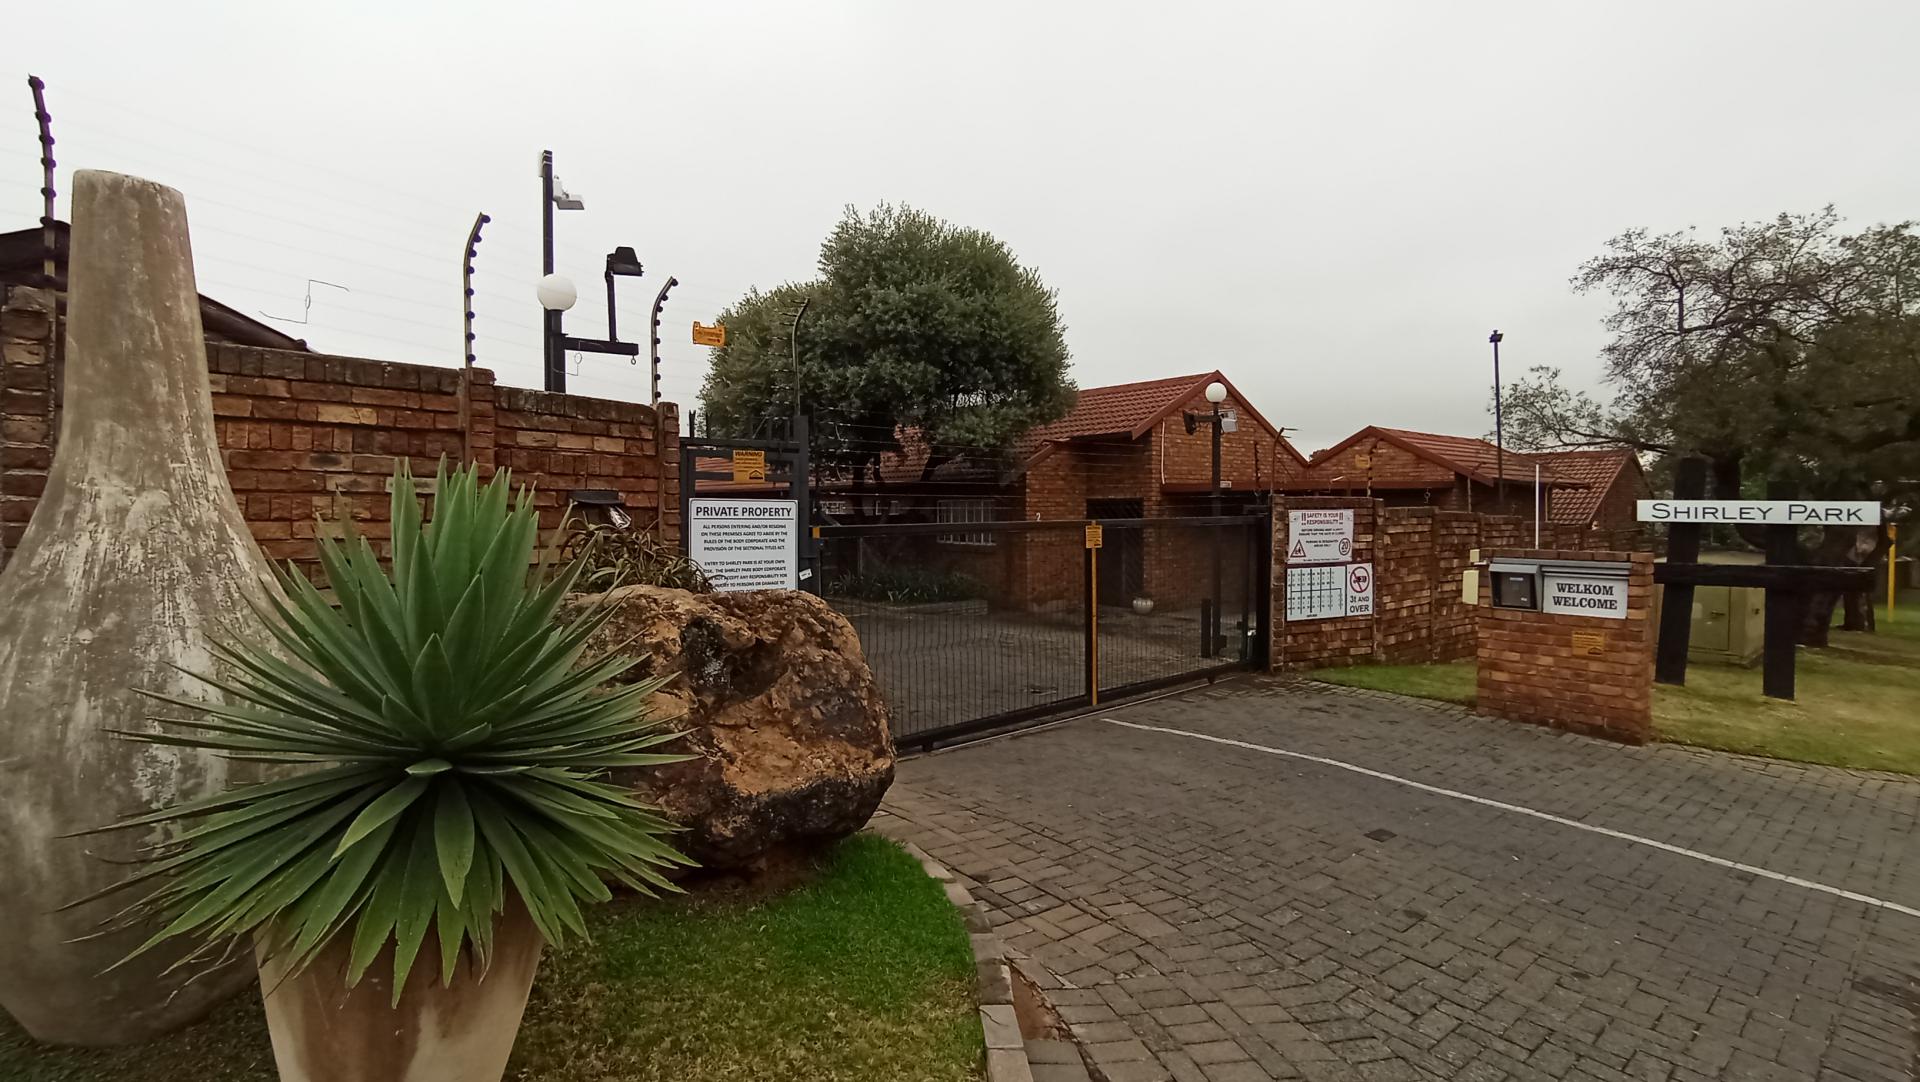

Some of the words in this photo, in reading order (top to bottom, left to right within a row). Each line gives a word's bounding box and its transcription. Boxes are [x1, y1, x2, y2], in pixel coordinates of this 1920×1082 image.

[696, 506, 739, 516] PRIVATE
[742, 507, 792, 517] PROPERTY
[1651, 503, 1773, 520] SHIRLEY
[1788, 504, 1864, 522] PARK
[1556, 583, 1614, 596] WELKOM
[1552, 596, 1618, 610] WELCOME
